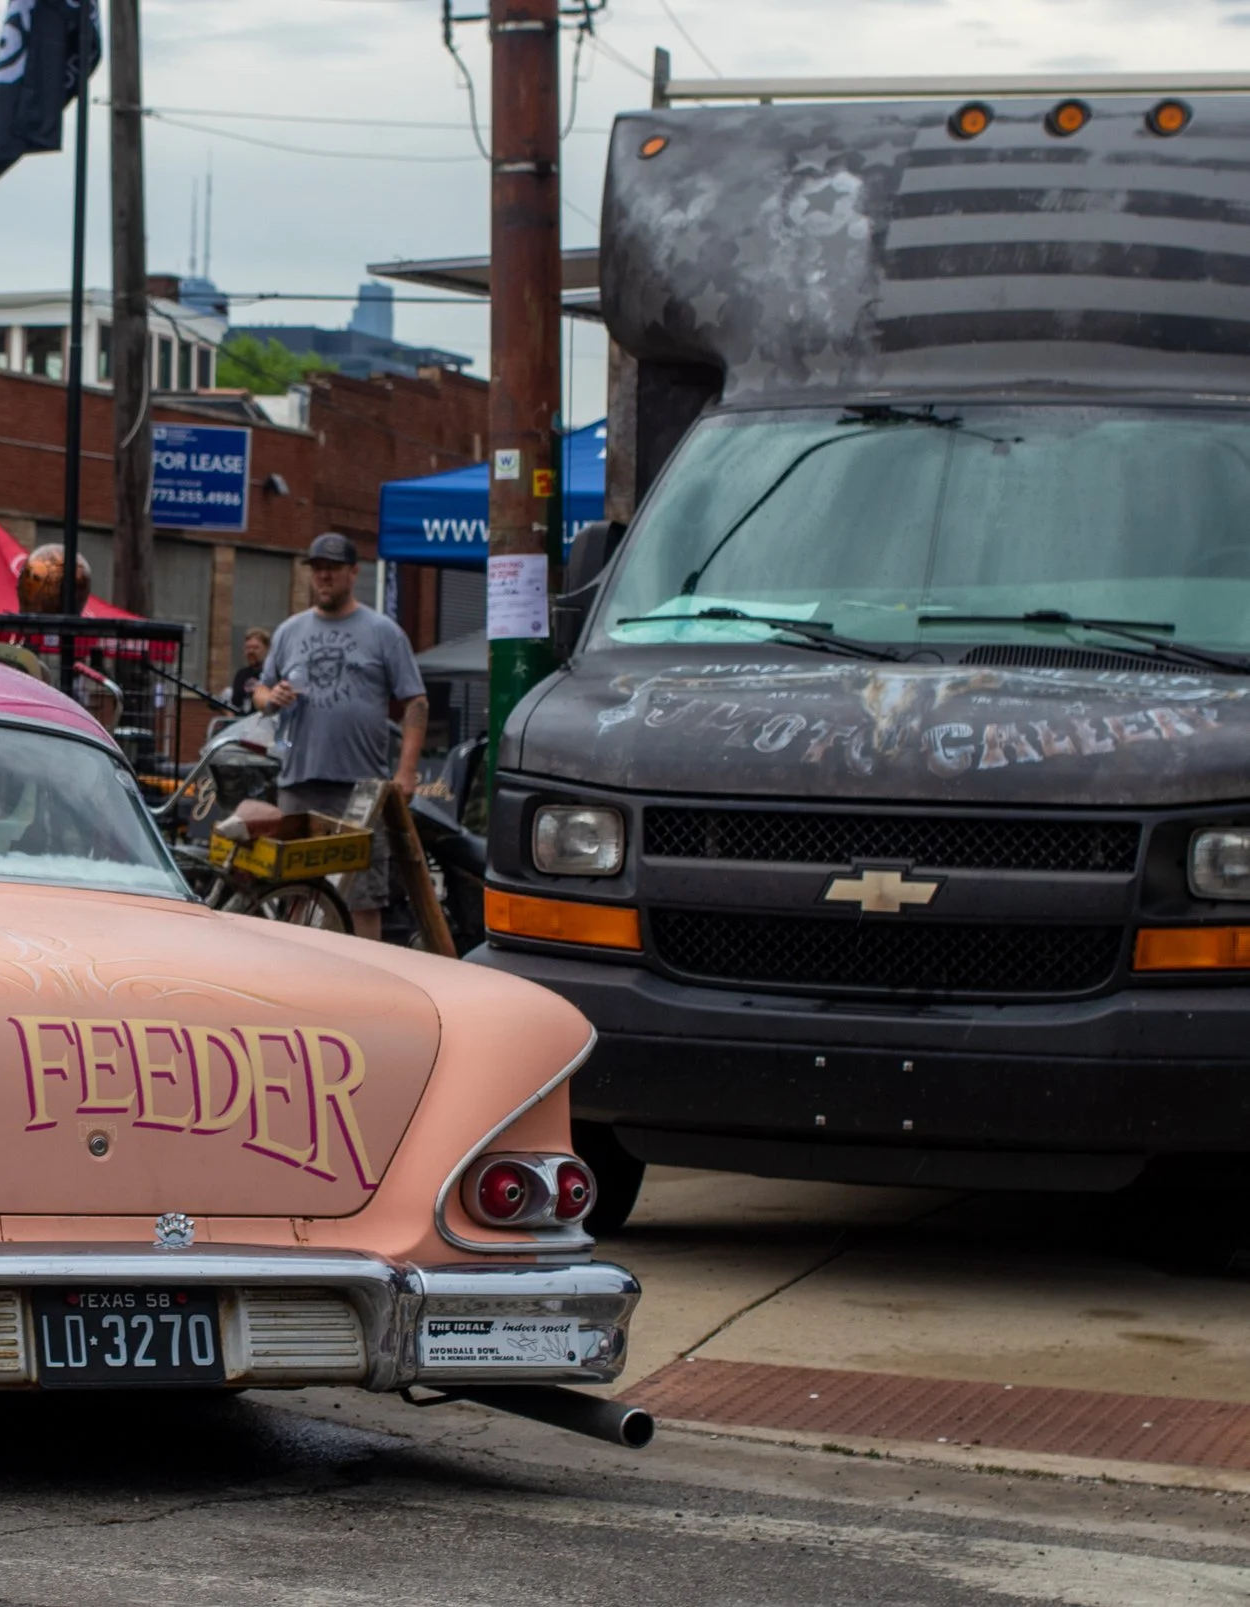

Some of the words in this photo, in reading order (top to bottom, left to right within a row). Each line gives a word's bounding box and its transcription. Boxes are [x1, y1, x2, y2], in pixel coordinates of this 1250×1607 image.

[152, 450, 187, 471] FOR
[190, 452, 243, 474] LEASE
[919, 705, 1223, 778] GALLERY
[285, 844, 367, 870] PEPSI
[7, 1016, 380, 1191] FEEDER
[78, 1294, 136, 1308] TEXAS
[146, 1294, 171, 1308] 58
[430, 1323, 450, 1332] THE
[539, 1323, 571, 1333] sport
[429, 1347, 474, 1355] AVONDALE
[477, 1347, 500, 1355] BOWL
